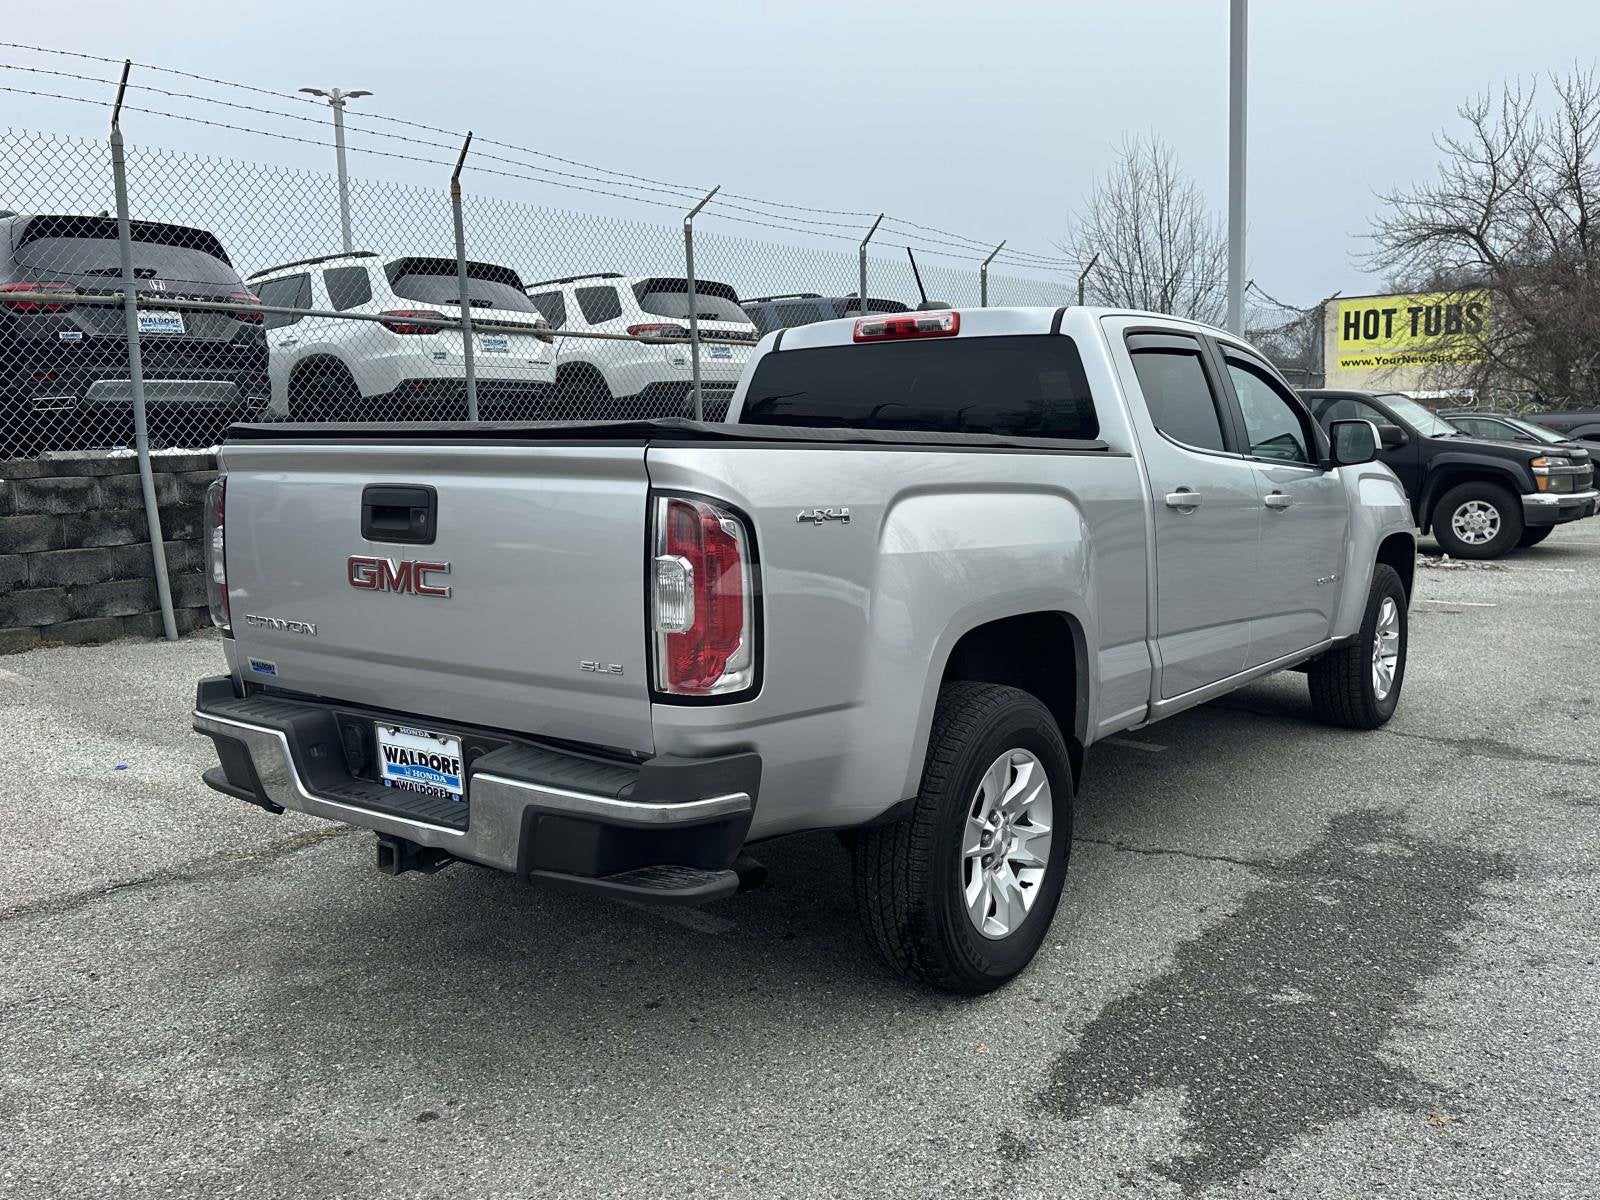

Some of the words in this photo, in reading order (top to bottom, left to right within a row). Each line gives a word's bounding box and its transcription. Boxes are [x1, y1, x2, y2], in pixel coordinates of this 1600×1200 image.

[1343, 308, 1397, 341] HOT
[1407, 302, 1484, 337] TUBS
[347, 554, 452, 599] GMC
[245, 614, 318, 637] CANYON
[399, 727, 431, 739] HONDA
[382, 744, 460, 776] WALDORF
[411, 768, 448, 784] HONDA
[396, 779, 447, 799] WALDORF
